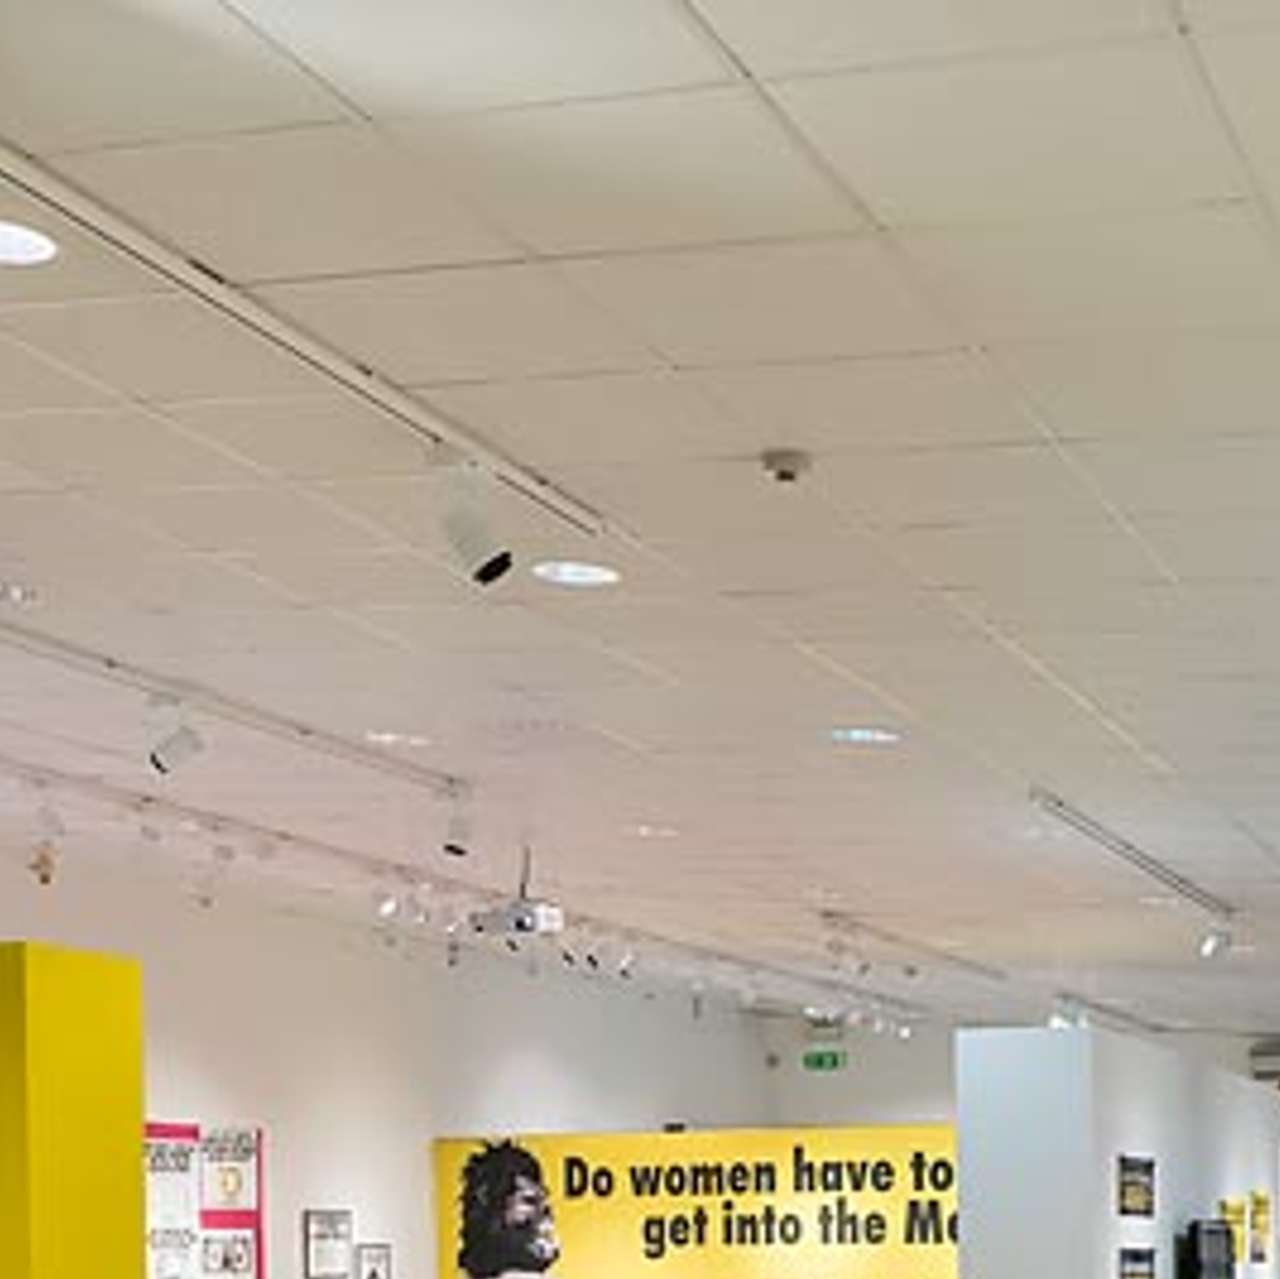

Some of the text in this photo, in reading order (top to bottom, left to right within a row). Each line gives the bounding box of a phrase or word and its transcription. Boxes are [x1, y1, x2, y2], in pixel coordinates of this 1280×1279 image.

[563, 1145, 954, 1198] Do women have to
[643, 1206, 709, 1259] get
[721, 1200, 803, 1246] into
[818, 1198, 887, 1246] the
